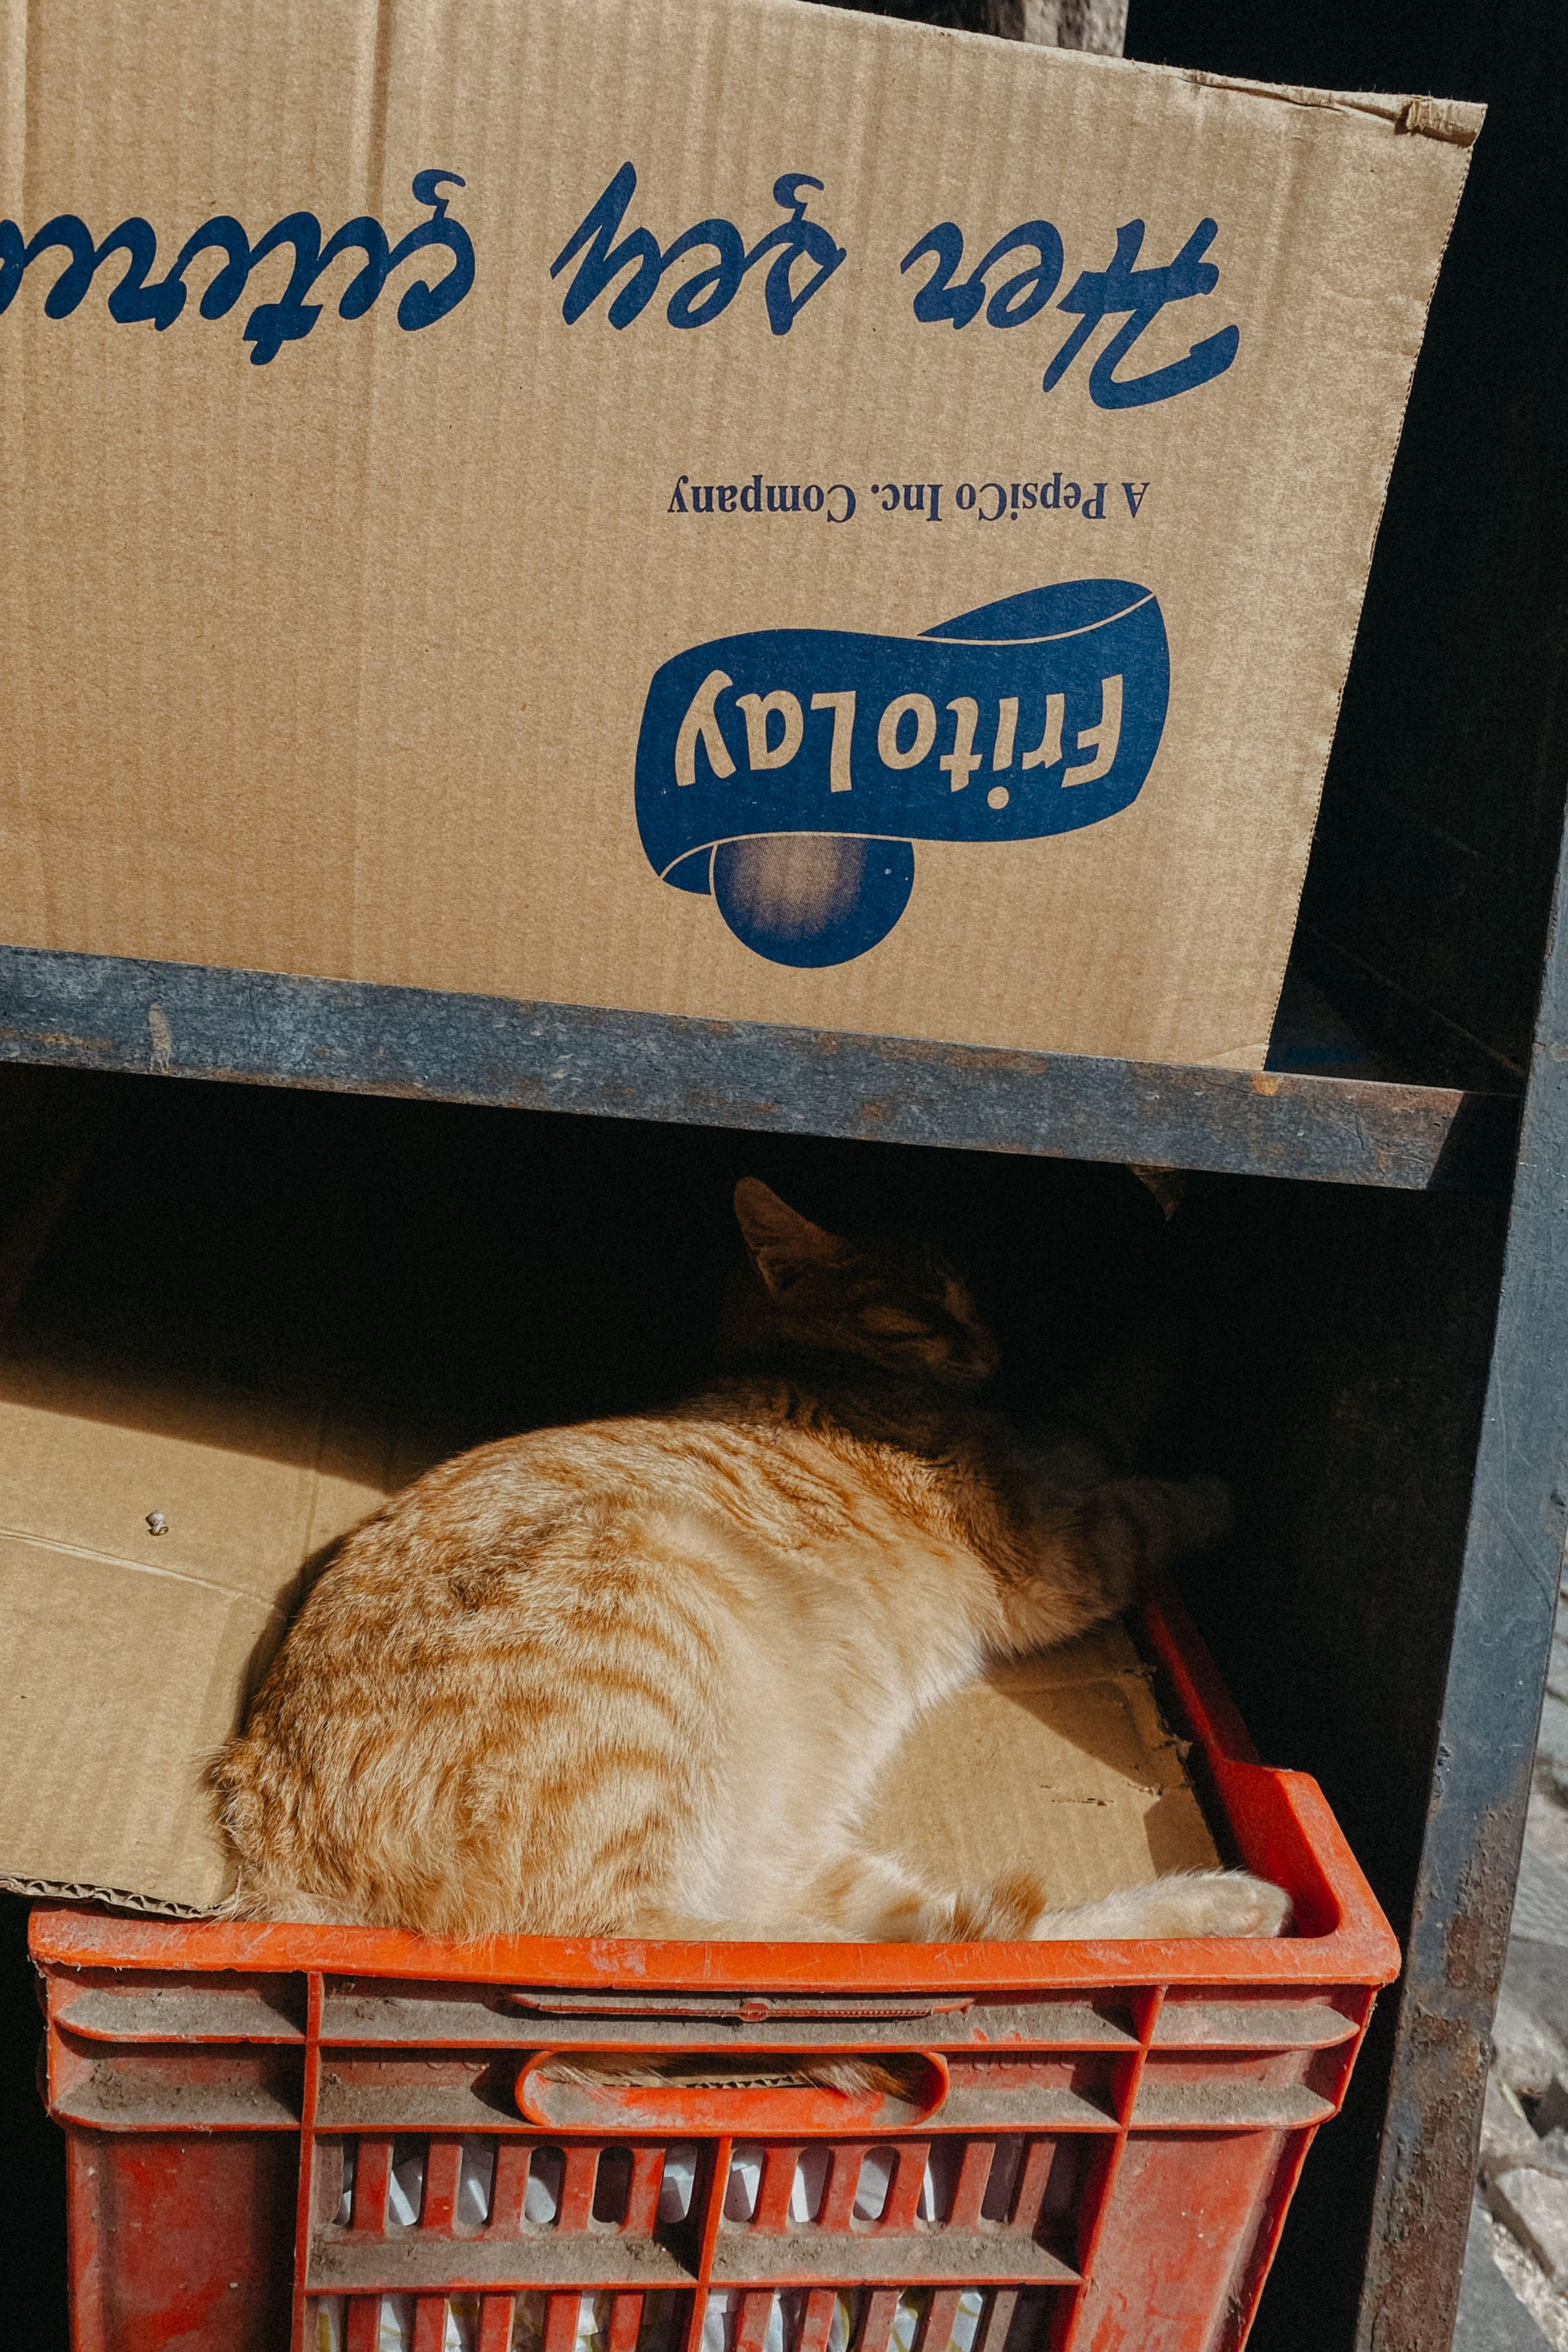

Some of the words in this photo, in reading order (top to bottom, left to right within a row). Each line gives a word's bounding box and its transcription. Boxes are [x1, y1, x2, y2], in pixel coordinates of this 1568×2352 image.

[551, 162, 846, 334] şey
[901, 218, 1239, 409] Her
[667, 475, 858, 523] Company
[870, 484, 944, 522] Inc.
[956, 472, 1109, 520] PepsiCo
[1121, 481, 1151, 519] A
[675, 670, 856, 791] Lay
[878, 674, 1123, 809] Frito
